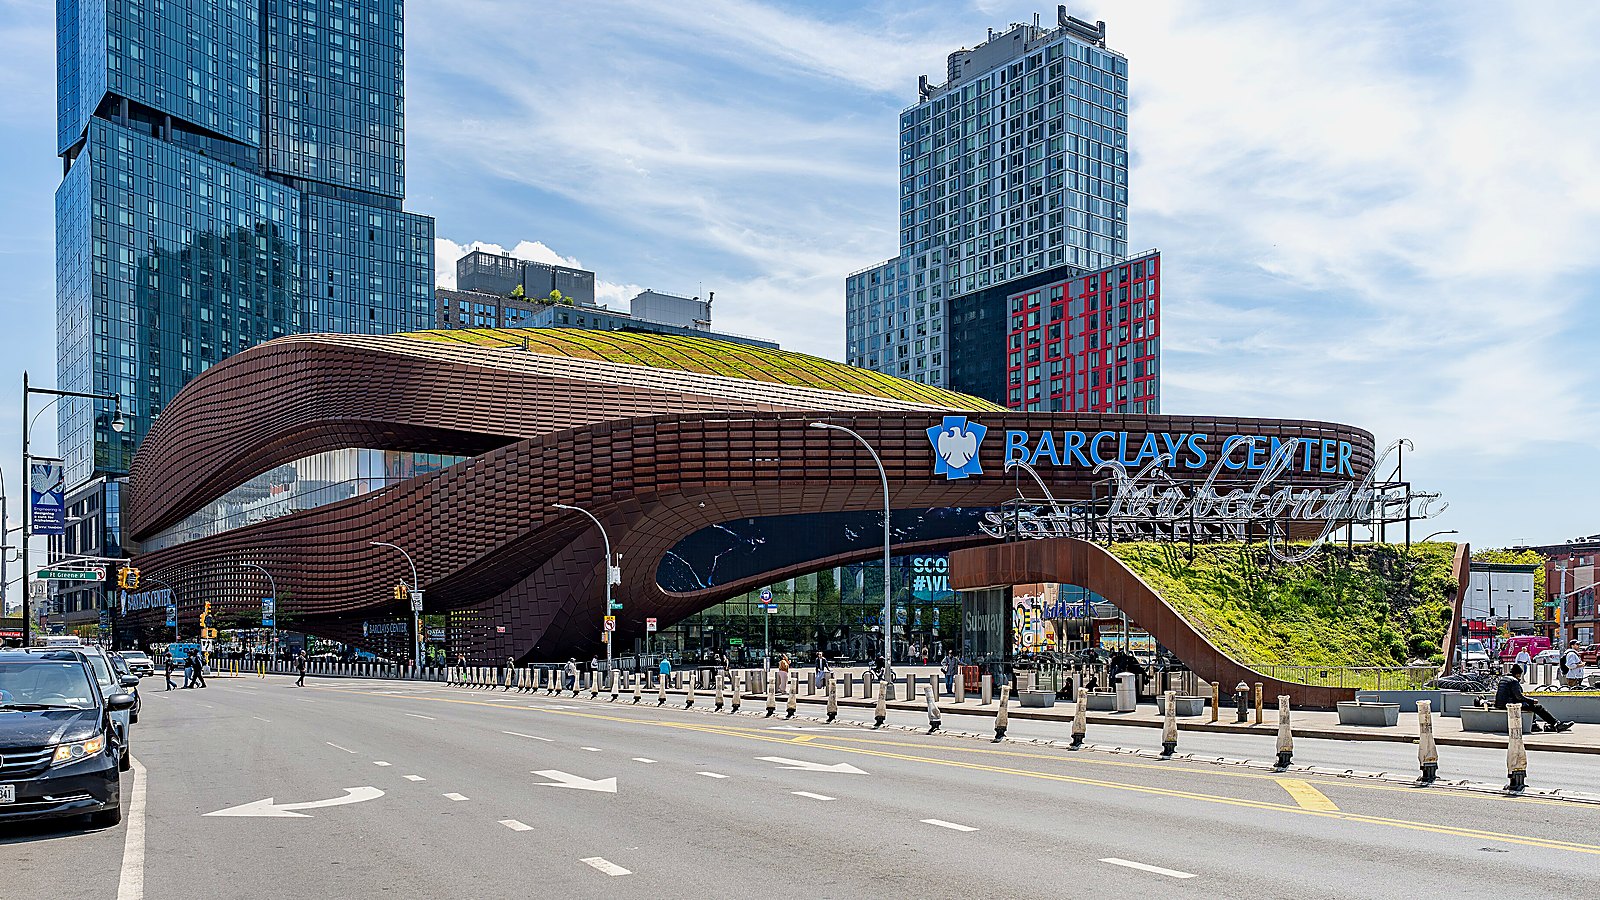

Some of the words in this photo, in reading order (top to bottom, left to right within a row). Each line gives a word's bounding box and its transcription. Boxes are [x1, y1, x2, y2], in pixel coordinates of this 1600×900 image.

[1005, 430, 1208, 469] BARCLAYS
[1221, 434, 1356, 478] CENTER
[913, 557, 949, 574] SCO
[913, 575, 954, 591] #WI
[128, 592, 151, 611] BARCLAYS
[151, 588, 172, 607] CENTER
[369, 624, 390, 634] BARCLAYS
[389, 622, 408, 633] CENTER
[965, 610, 1002, 636] Subway
